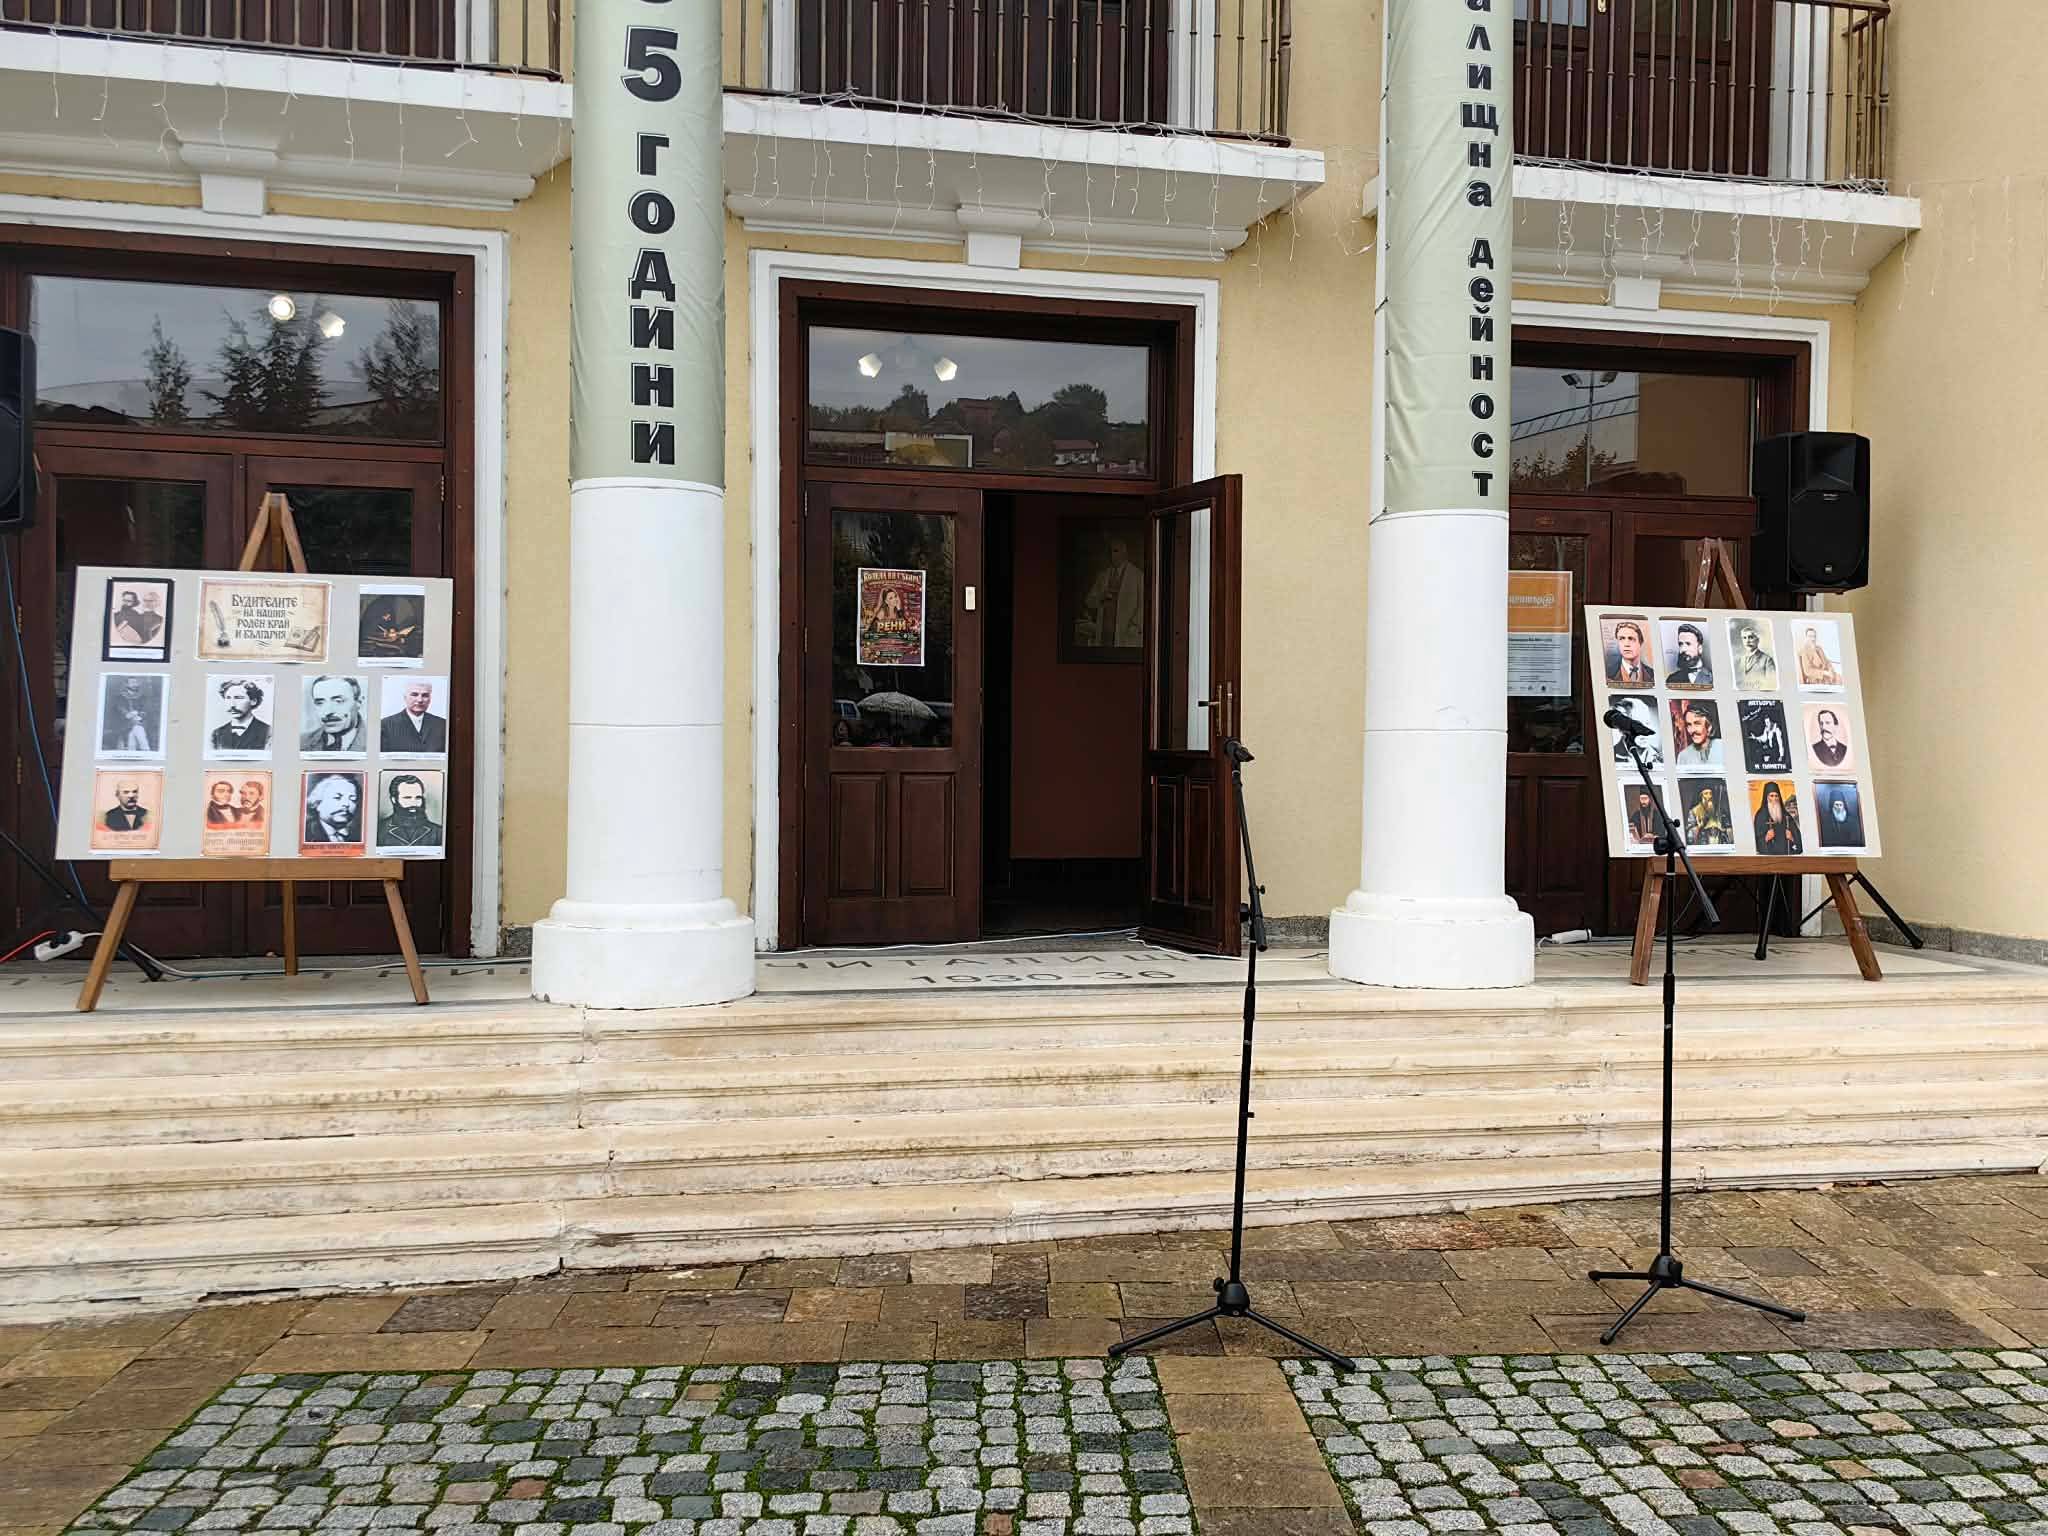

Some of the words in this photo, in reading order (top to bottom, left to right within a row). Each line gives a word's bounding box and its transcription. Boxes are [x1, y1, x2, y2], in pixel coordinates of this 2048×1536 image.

[621, 0, 682, 101] 5
[1467, 237, 1495, 497] дейност
[237, 618, 265, 628] РОДЕН
[235, 629, 242, 639] И
[243, 630, 287, 639] БЪЛГАРИЯ
[764, 953, 1189, 969] ЧИТАЛИЩ
[912, 970, 1176, 984] 1930-36
